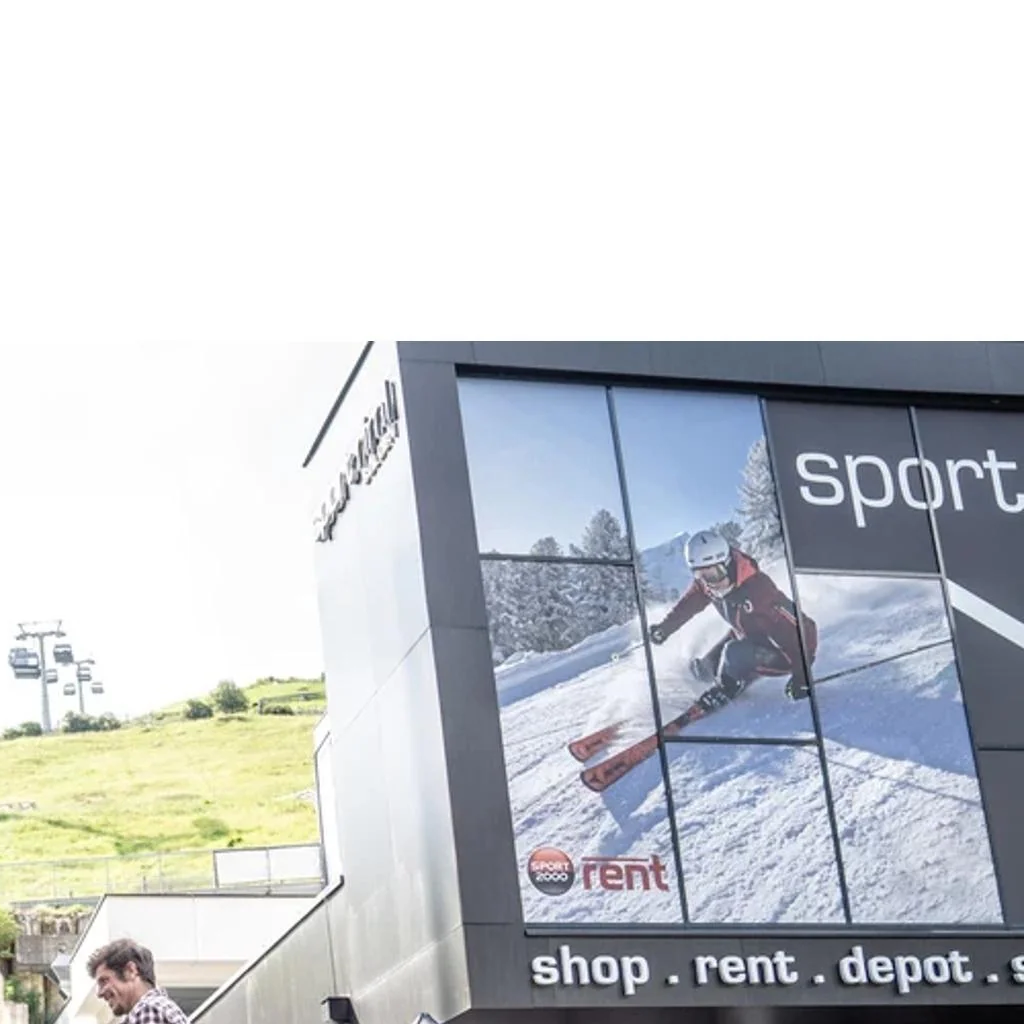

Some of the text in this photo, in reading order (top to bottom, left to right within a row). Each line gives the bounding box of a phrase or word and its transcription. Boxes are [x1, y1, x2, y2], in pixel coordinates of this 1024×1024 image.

[795, 449, 1024, 528] sport
[531, 861, 570, 872] SPORT
[535, 872, 569, 882] 2000
[582, 855, 669, 892] rent
[531, 944, 650, 996] shop
[694, 950, 799, 985] rent
[838, 945, 974, 994] depot
